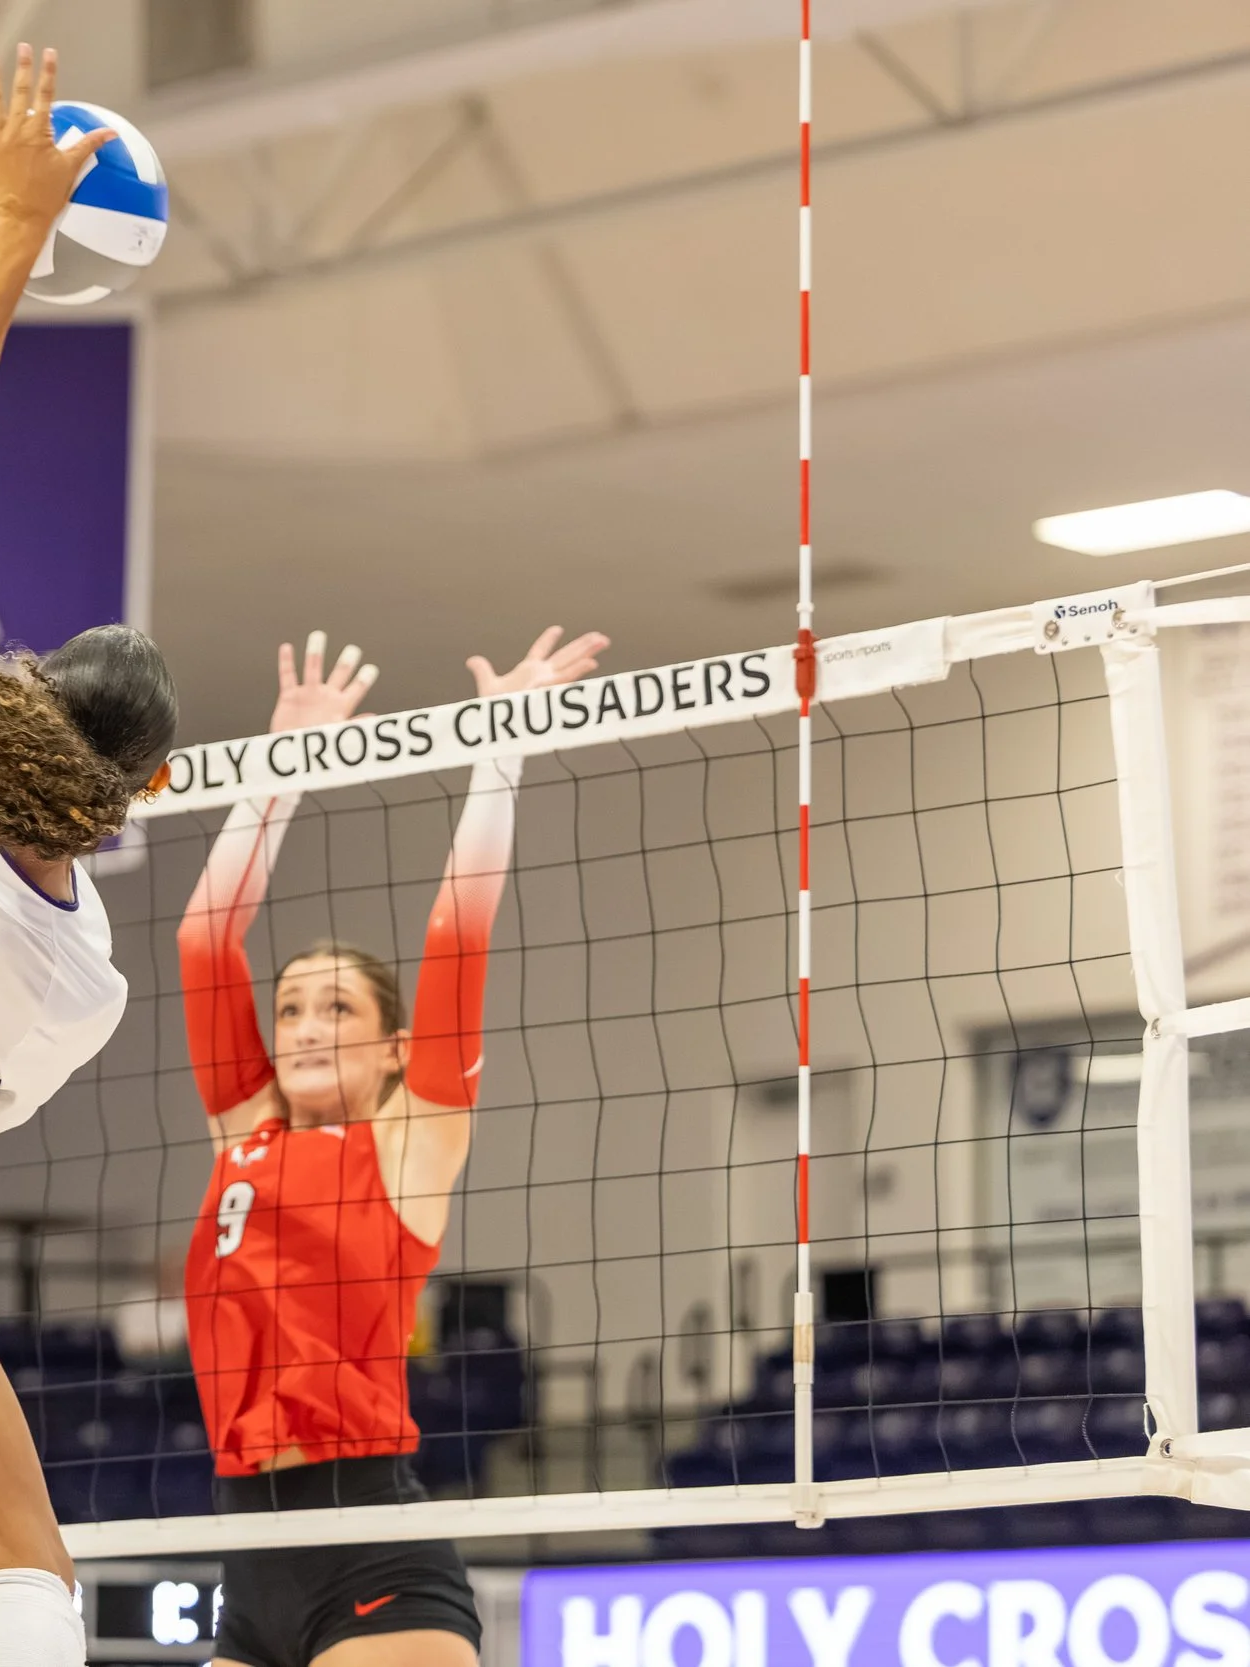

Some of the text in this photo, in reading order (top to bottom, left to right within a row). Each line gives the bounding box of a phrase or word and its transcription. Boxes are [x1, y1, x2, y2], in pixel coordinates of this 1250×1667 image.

[1069, 600, 1118, 617] Senoh
[168, 652, 771, 795] OLY CROSS CRUSADERS
[215, 1180, 255, 1258] 9
